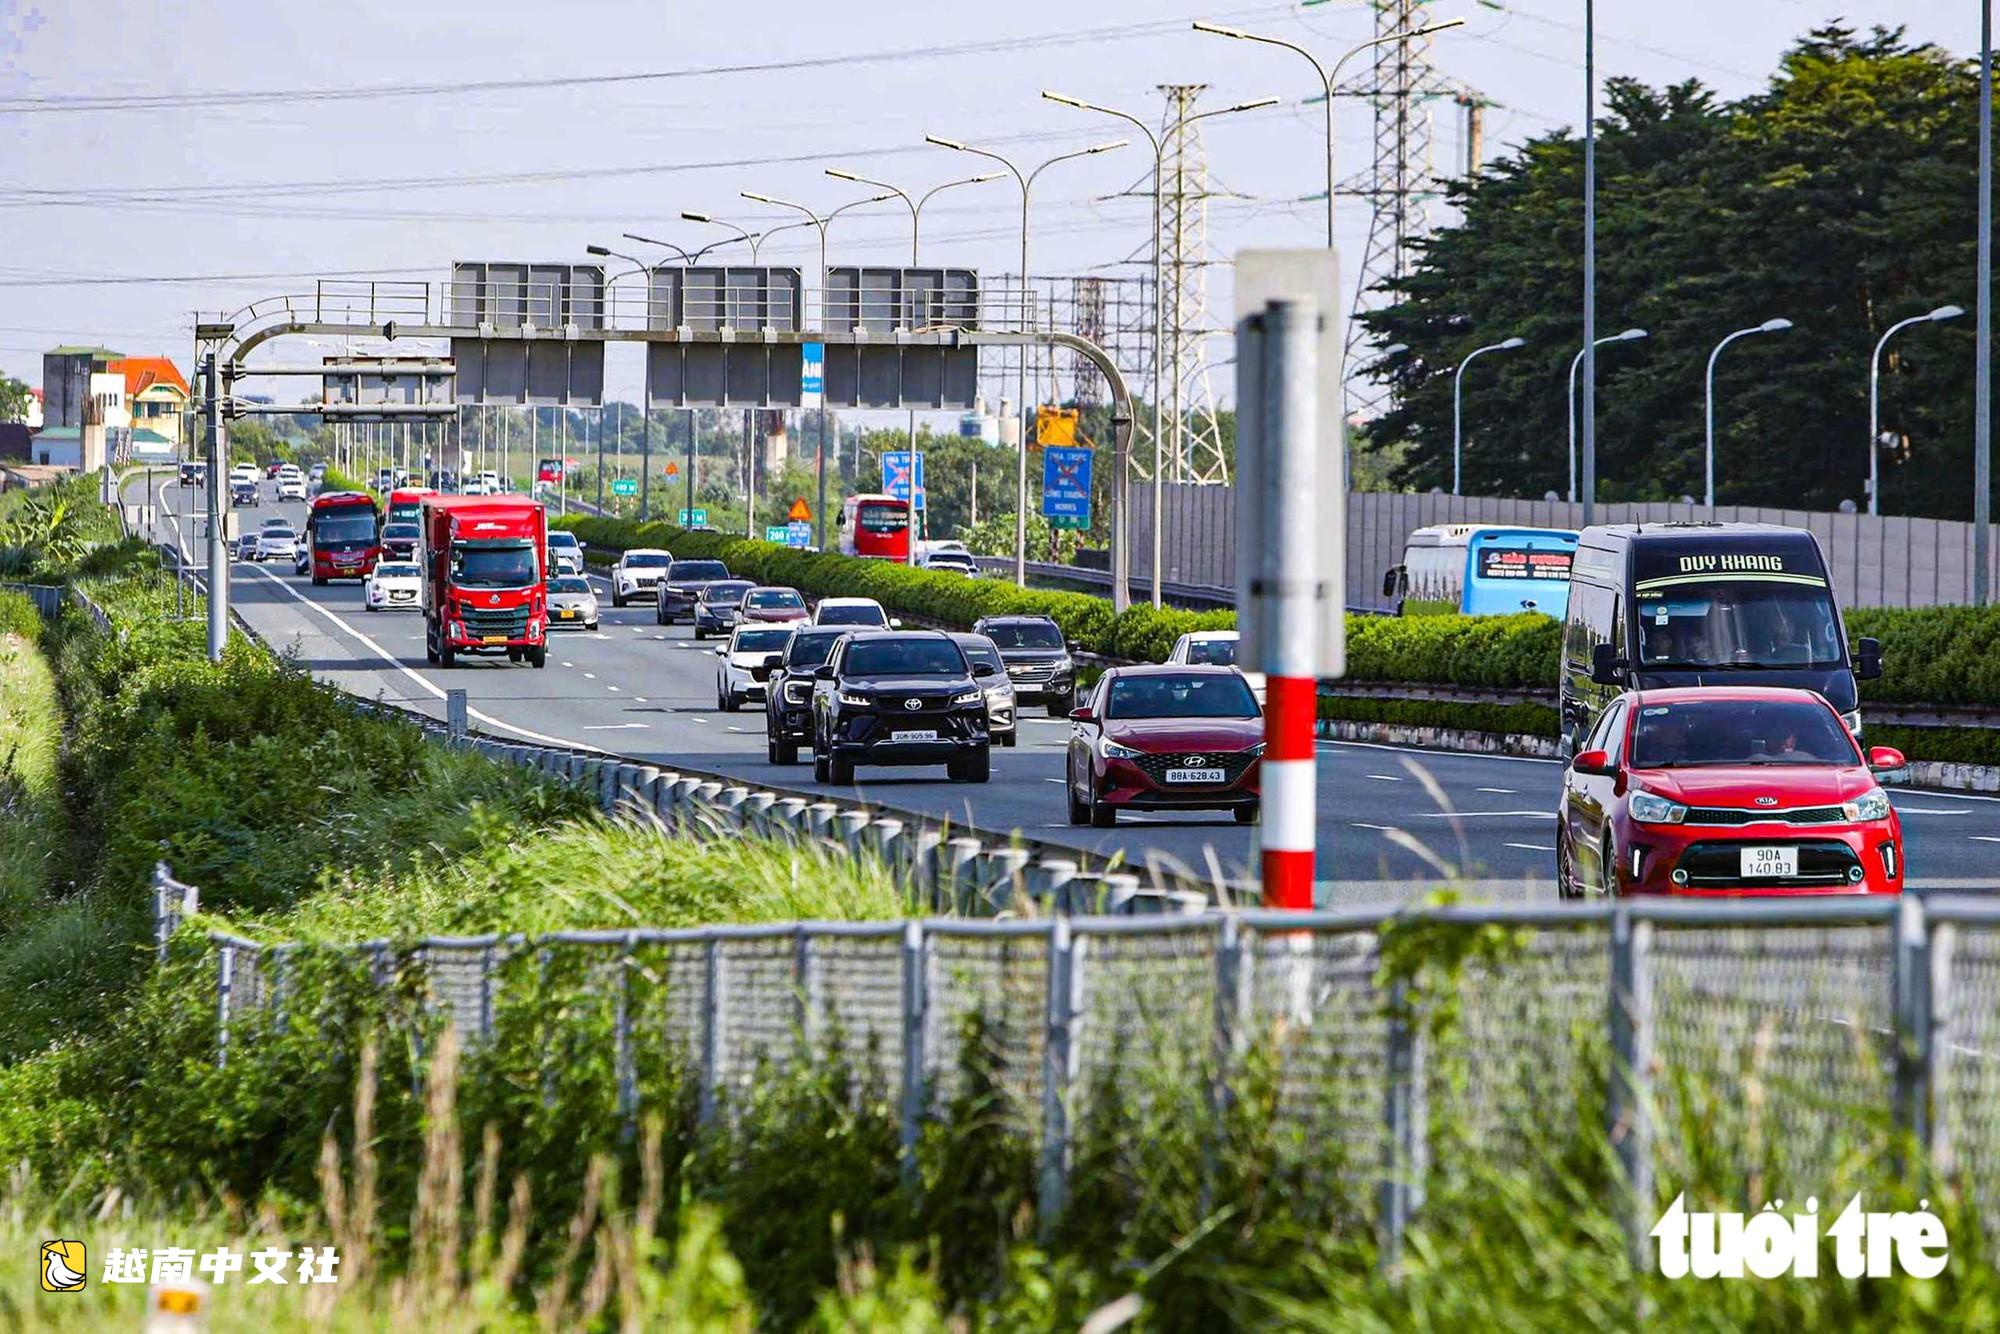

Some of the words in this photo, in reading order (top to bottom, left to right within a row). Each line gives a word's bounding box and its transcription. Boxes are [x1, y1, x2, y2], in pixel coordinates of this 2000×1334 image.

[1679, 555, 1717, 572] DUY
[1721, 554, 1783, 571] KHANG
[1171, 771, 1221, 781] 88A-628.43
[1757, 849, 1781, 861] 90A
[1749, 863, 1791, 875] 140.83
